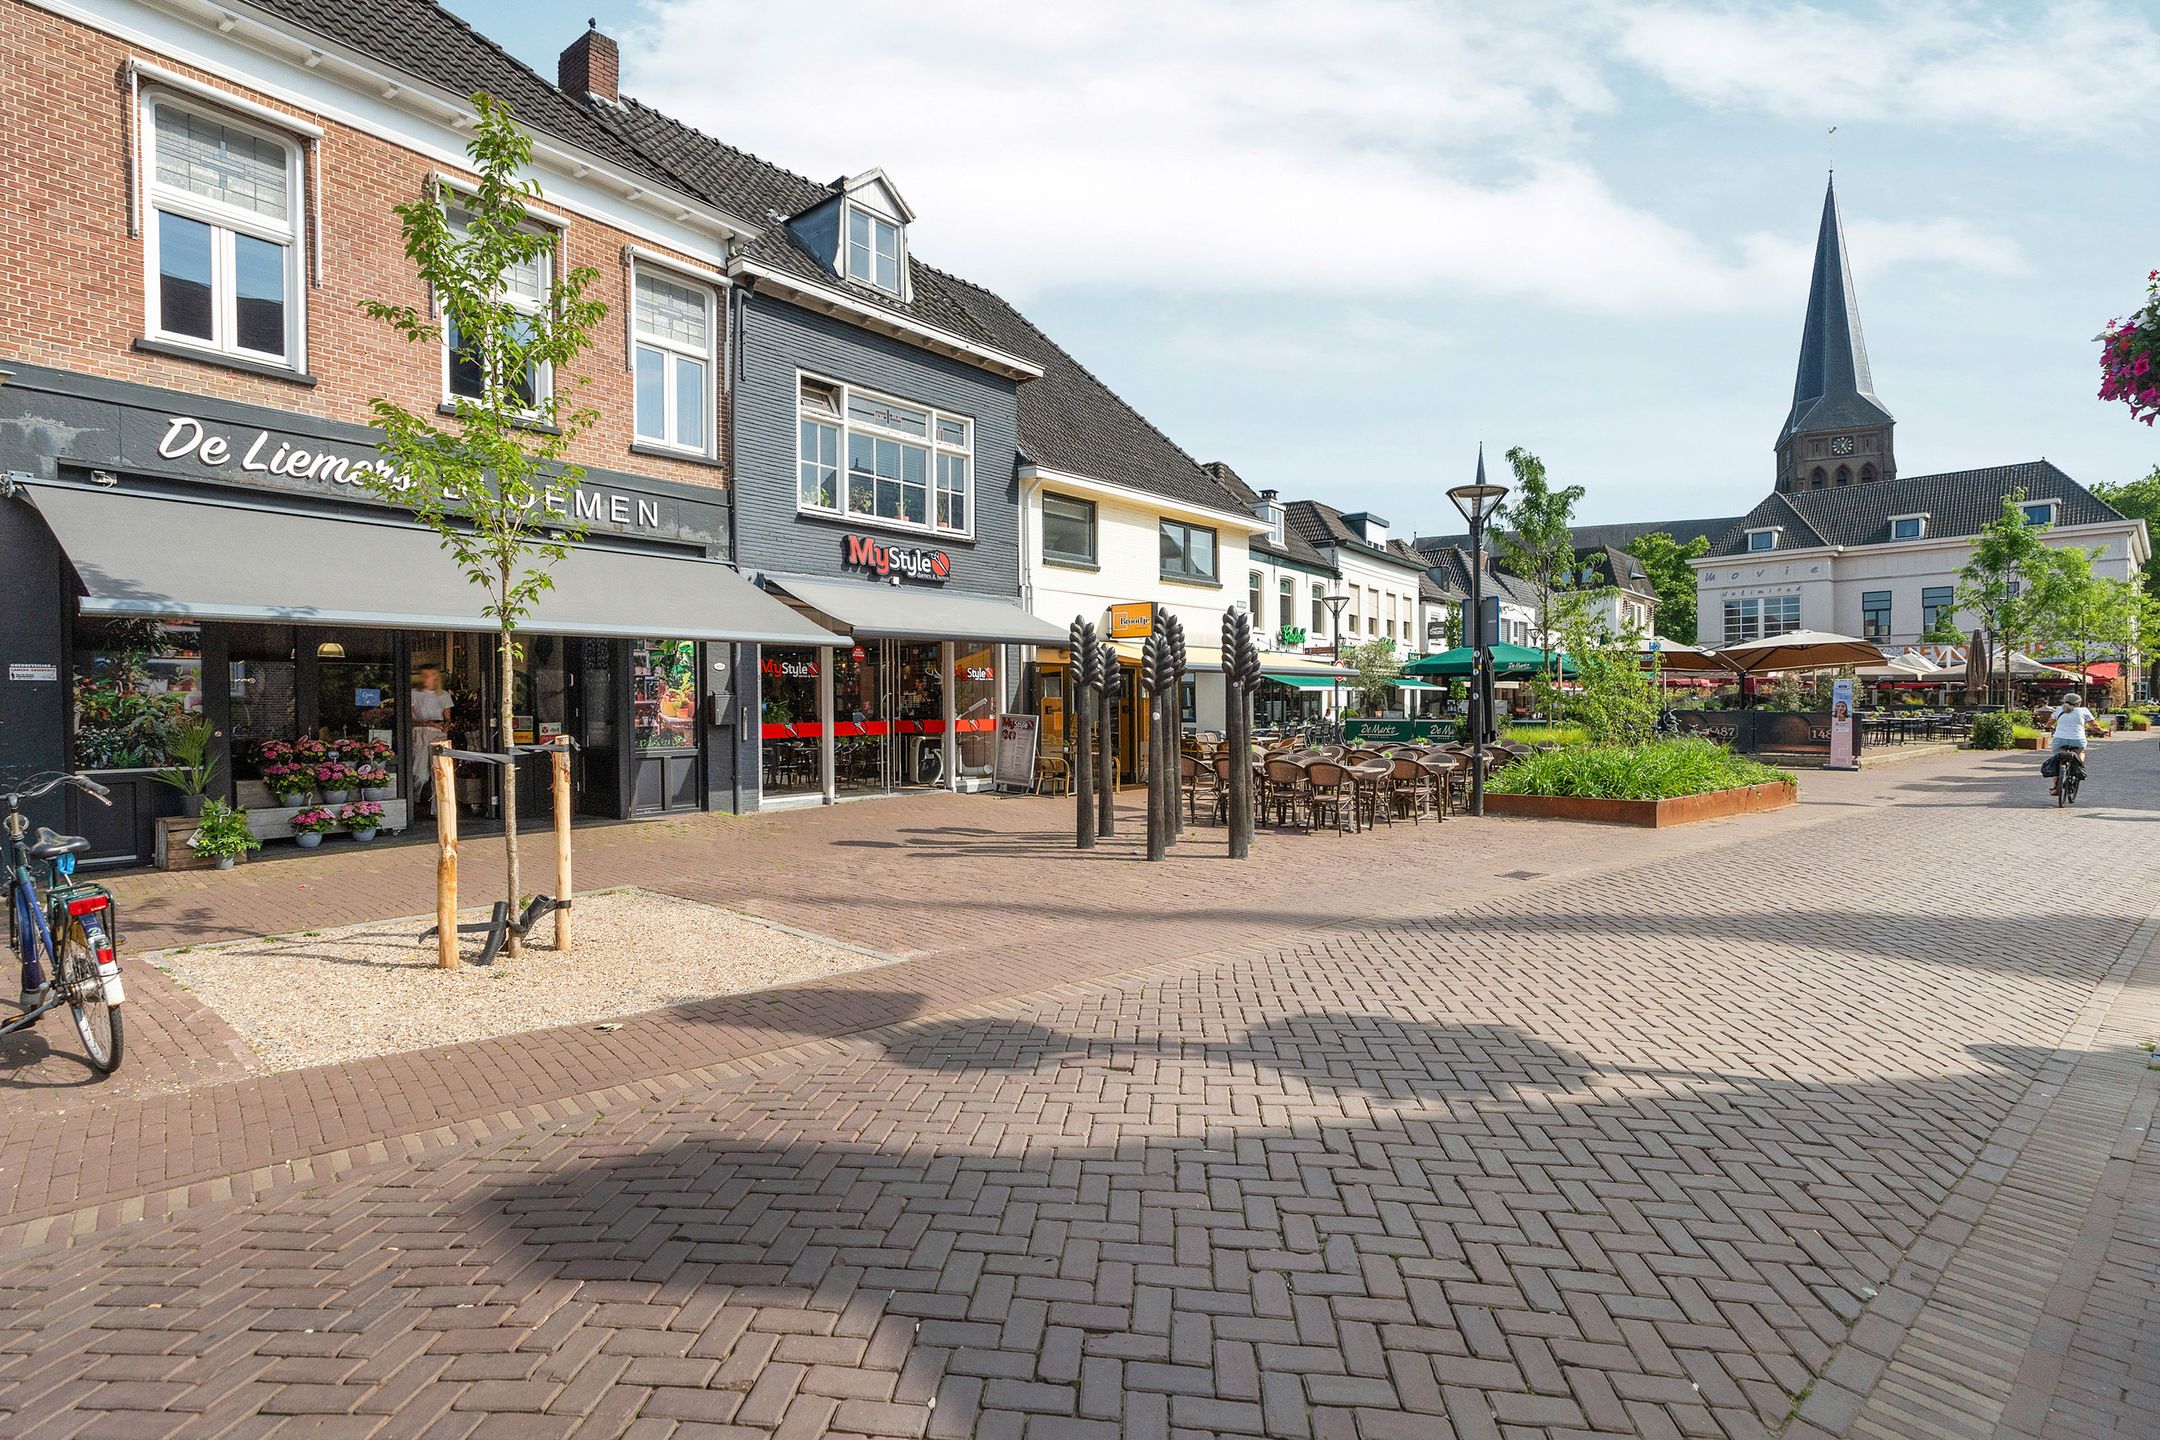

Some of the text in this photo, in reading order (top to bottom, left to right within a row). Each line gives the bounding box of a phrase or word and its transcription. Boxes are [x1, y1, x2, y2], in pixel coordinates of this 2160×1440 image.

[157, 417, 231, 466] De
[442, 472, 659, 529] OEMEN
[847, 534, 932, 579] MyStyle
[760, 658, 808, 678] MyStyle
[1360, 723, 1396, 735] De Markt
[1430, 724, 1441, 735] De
[1811, 728, 1832, 739] 148
